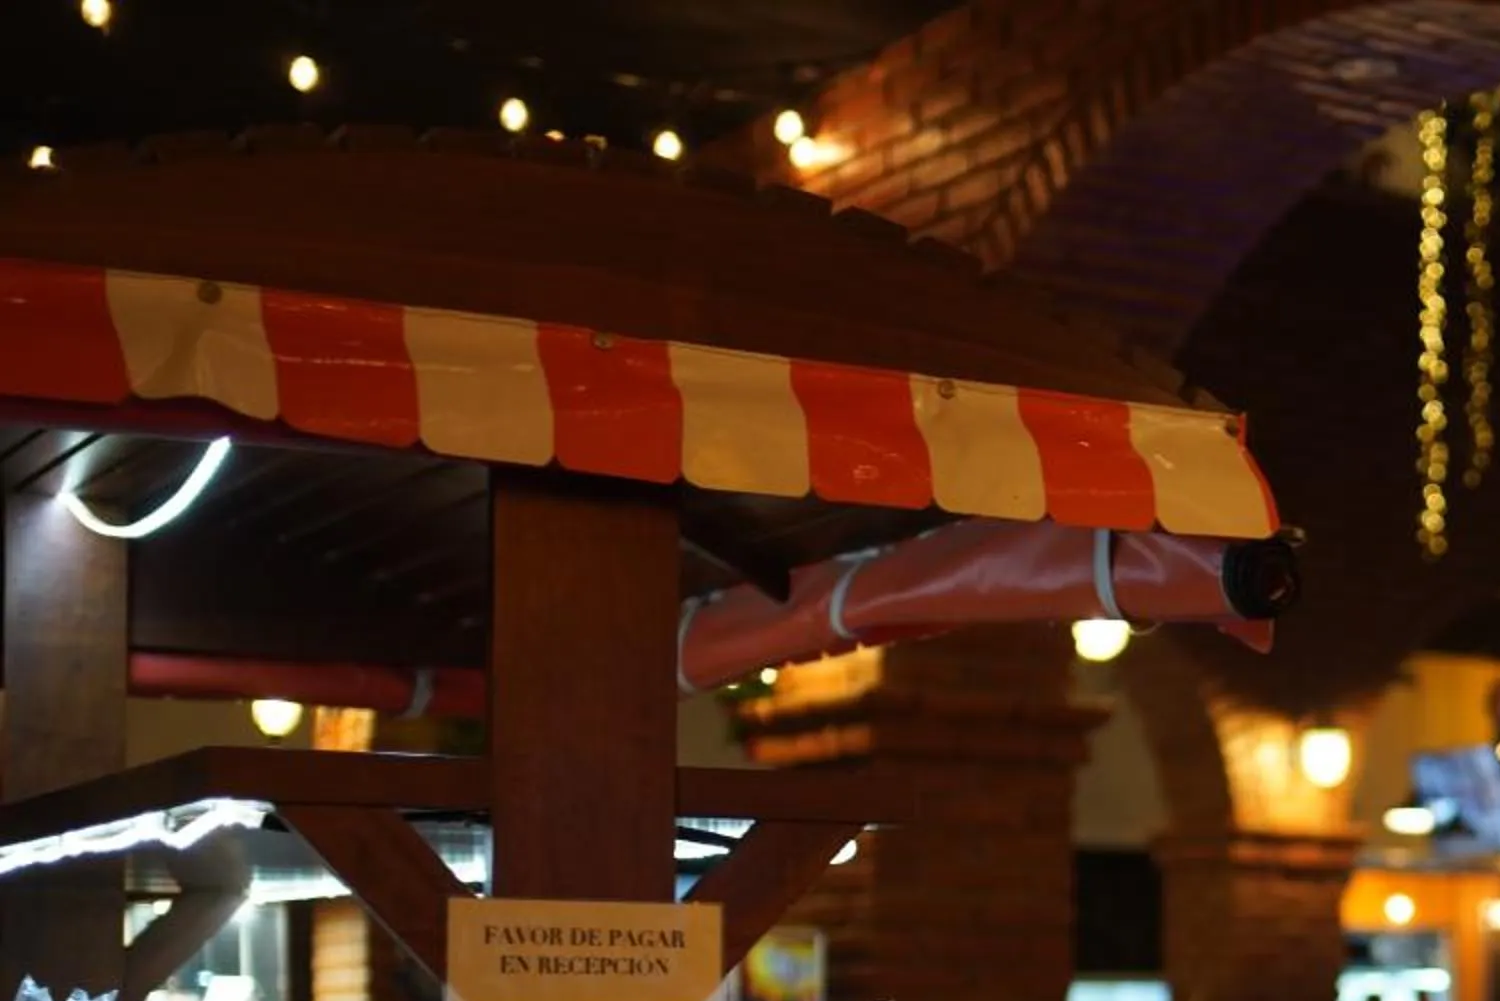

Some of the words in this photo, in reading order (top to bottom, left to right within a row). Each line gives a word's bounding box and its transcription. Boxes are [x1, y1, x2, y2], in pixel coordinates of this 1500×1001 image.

[483, 925, 564, 946] FAVOR
[569, 926, 603, 948] DE
[608, 928, 686, 949] PAGAR
[500, 955, 531, 975] EN
[537, 952, 671, 975] RECEPCIÓN
